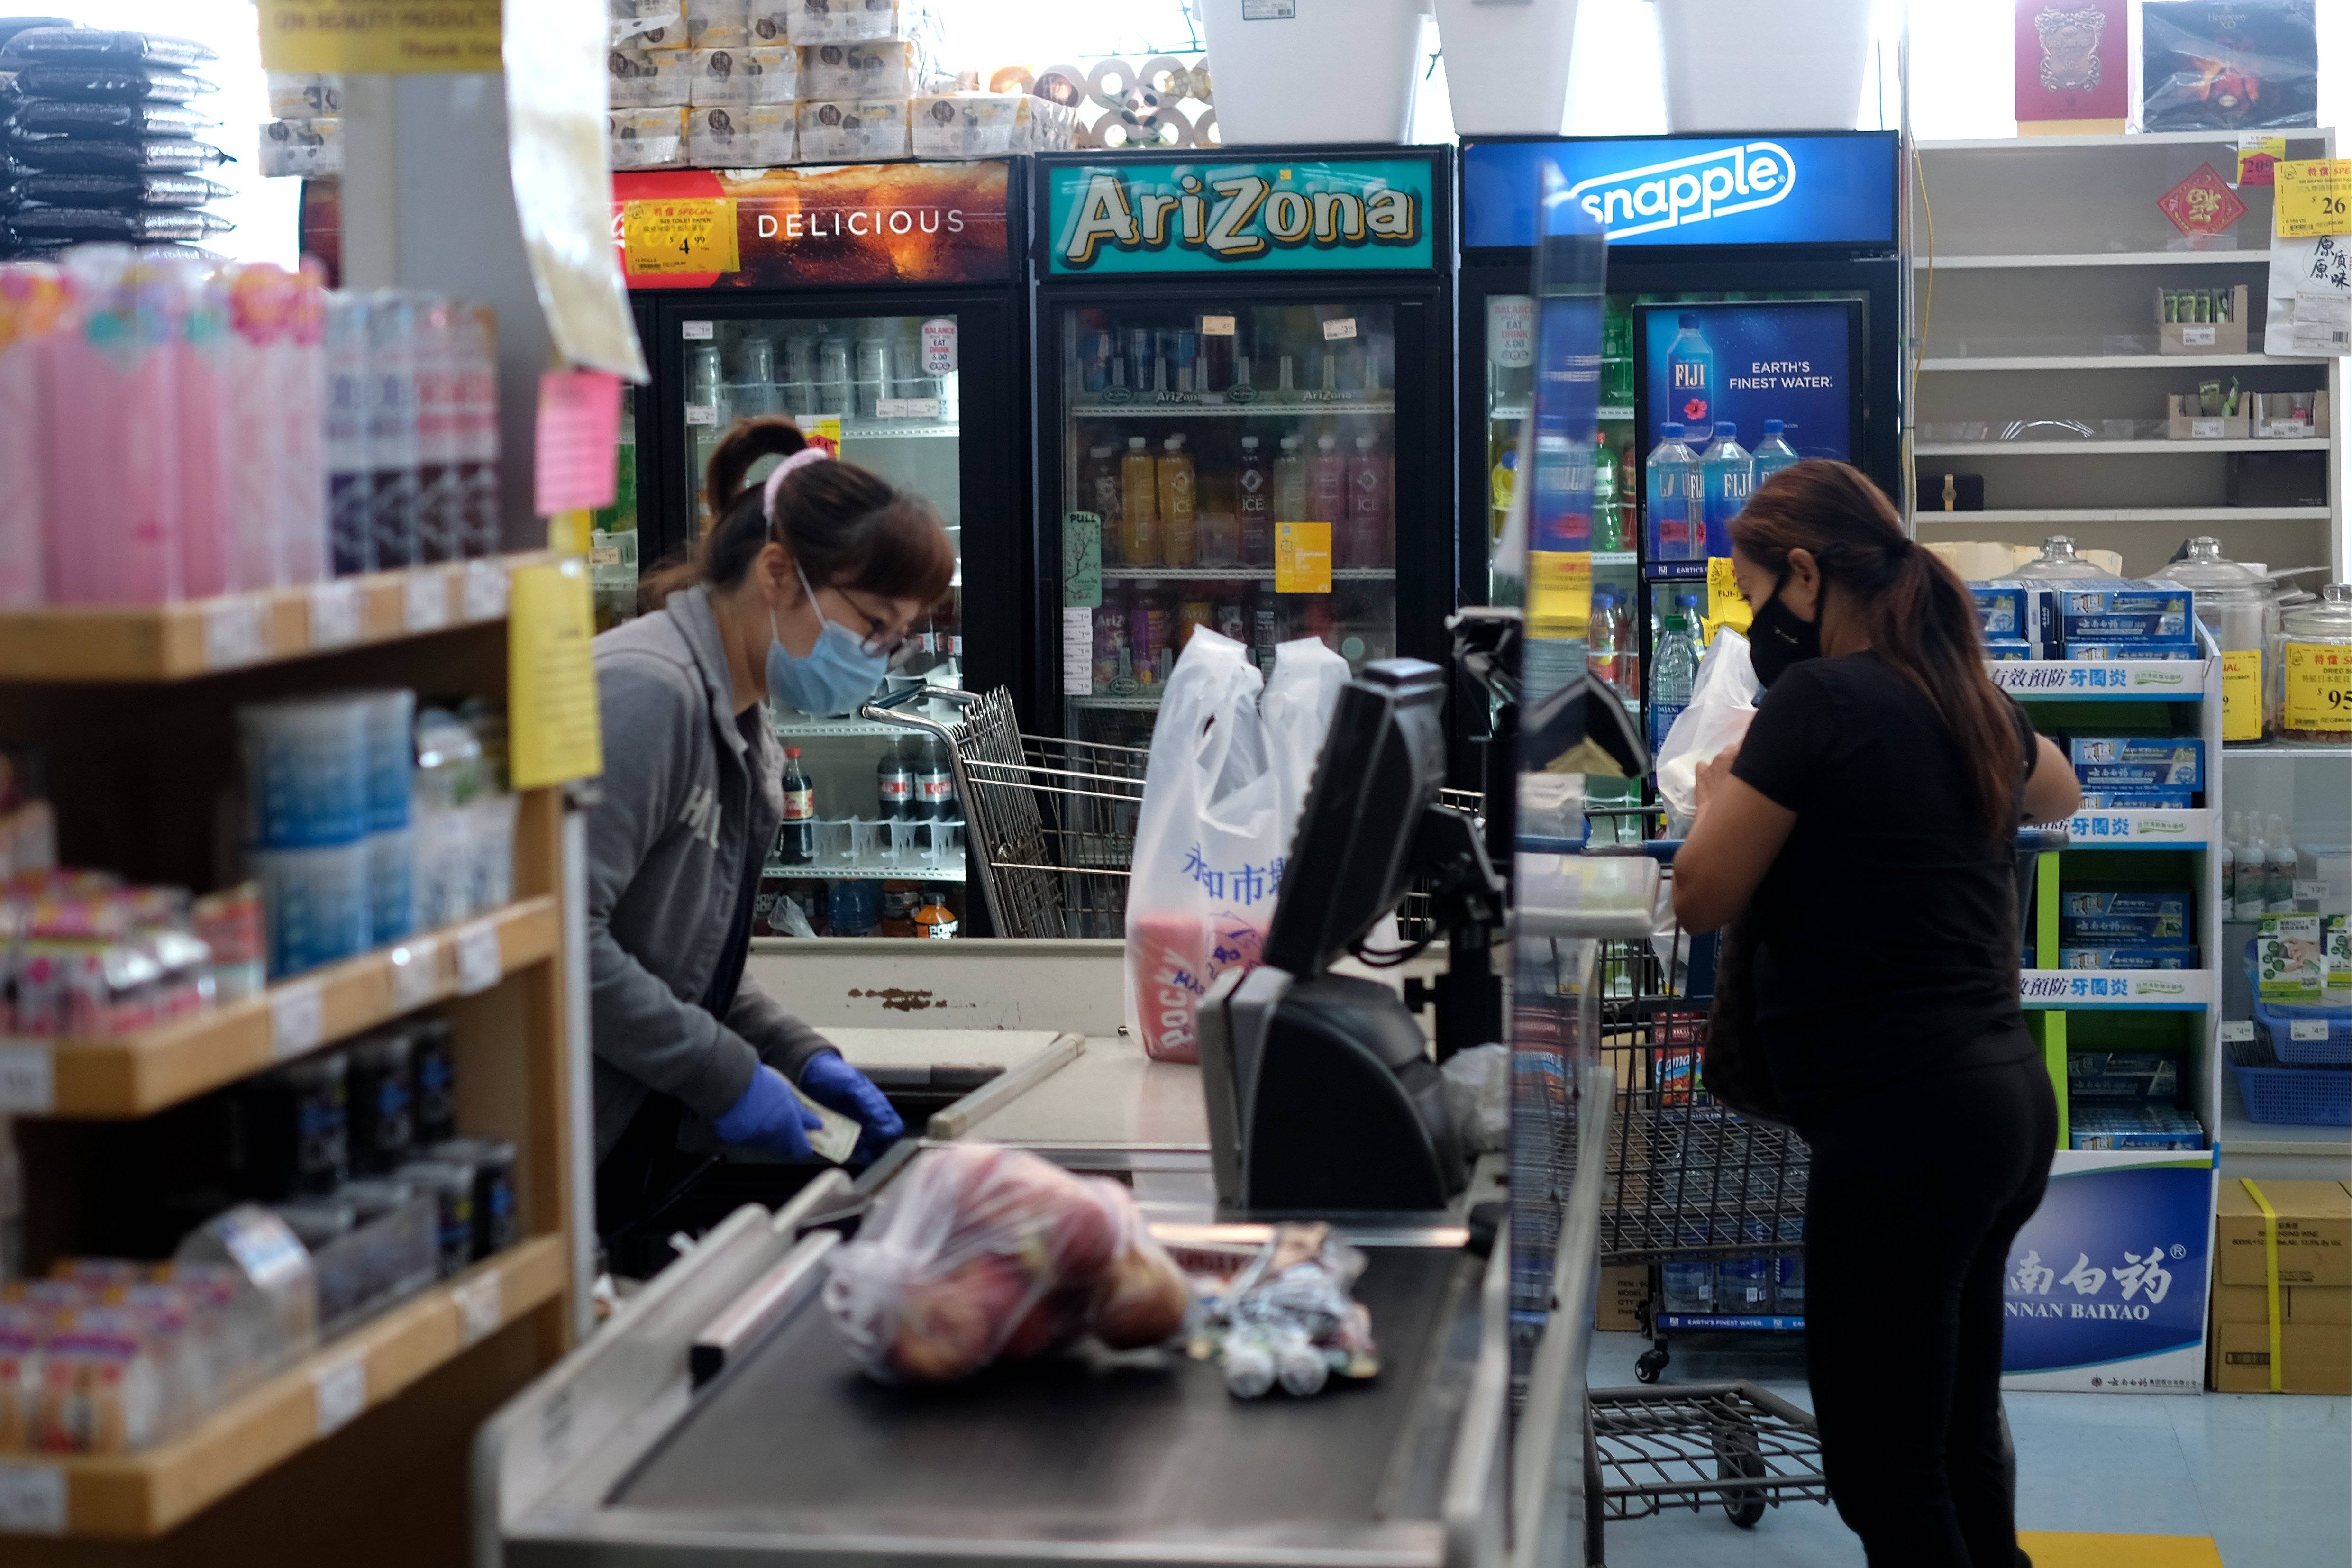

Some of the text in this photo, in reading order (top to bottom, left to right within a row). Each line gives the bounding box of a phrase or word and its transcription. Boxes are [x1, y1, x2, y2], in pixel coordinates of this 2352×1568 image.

[2208, 13, 2246, 22] Hennessy
[1581, 156, 1778, 225] snapple
[2322, 197, 2346, 214] 26
[758, 210, 965, 238] DELICIOUS
[1065, 173, 1415, 264] AriZona
[679, 238, 690, 254] 4
[1506, 321, 1522, 329] EAT
[1501, 330, 1528, 339] DRINK
[1513, 339, 1525, 348] DO
[1675, 363, 1705, 387] FIJI
[1752, 361, 1811, 374] EARTH'S
[1729, 377, 1777, 390] FINEST
[1172, 499, 1193, 514] ICE
[1242, 498, 1264, 512] ICE
[1070, 514, 1096, 523] PULL
[2328, 690, 2352, 711] 95
[2070, 1304, 2150, 1321] BAIYAO
